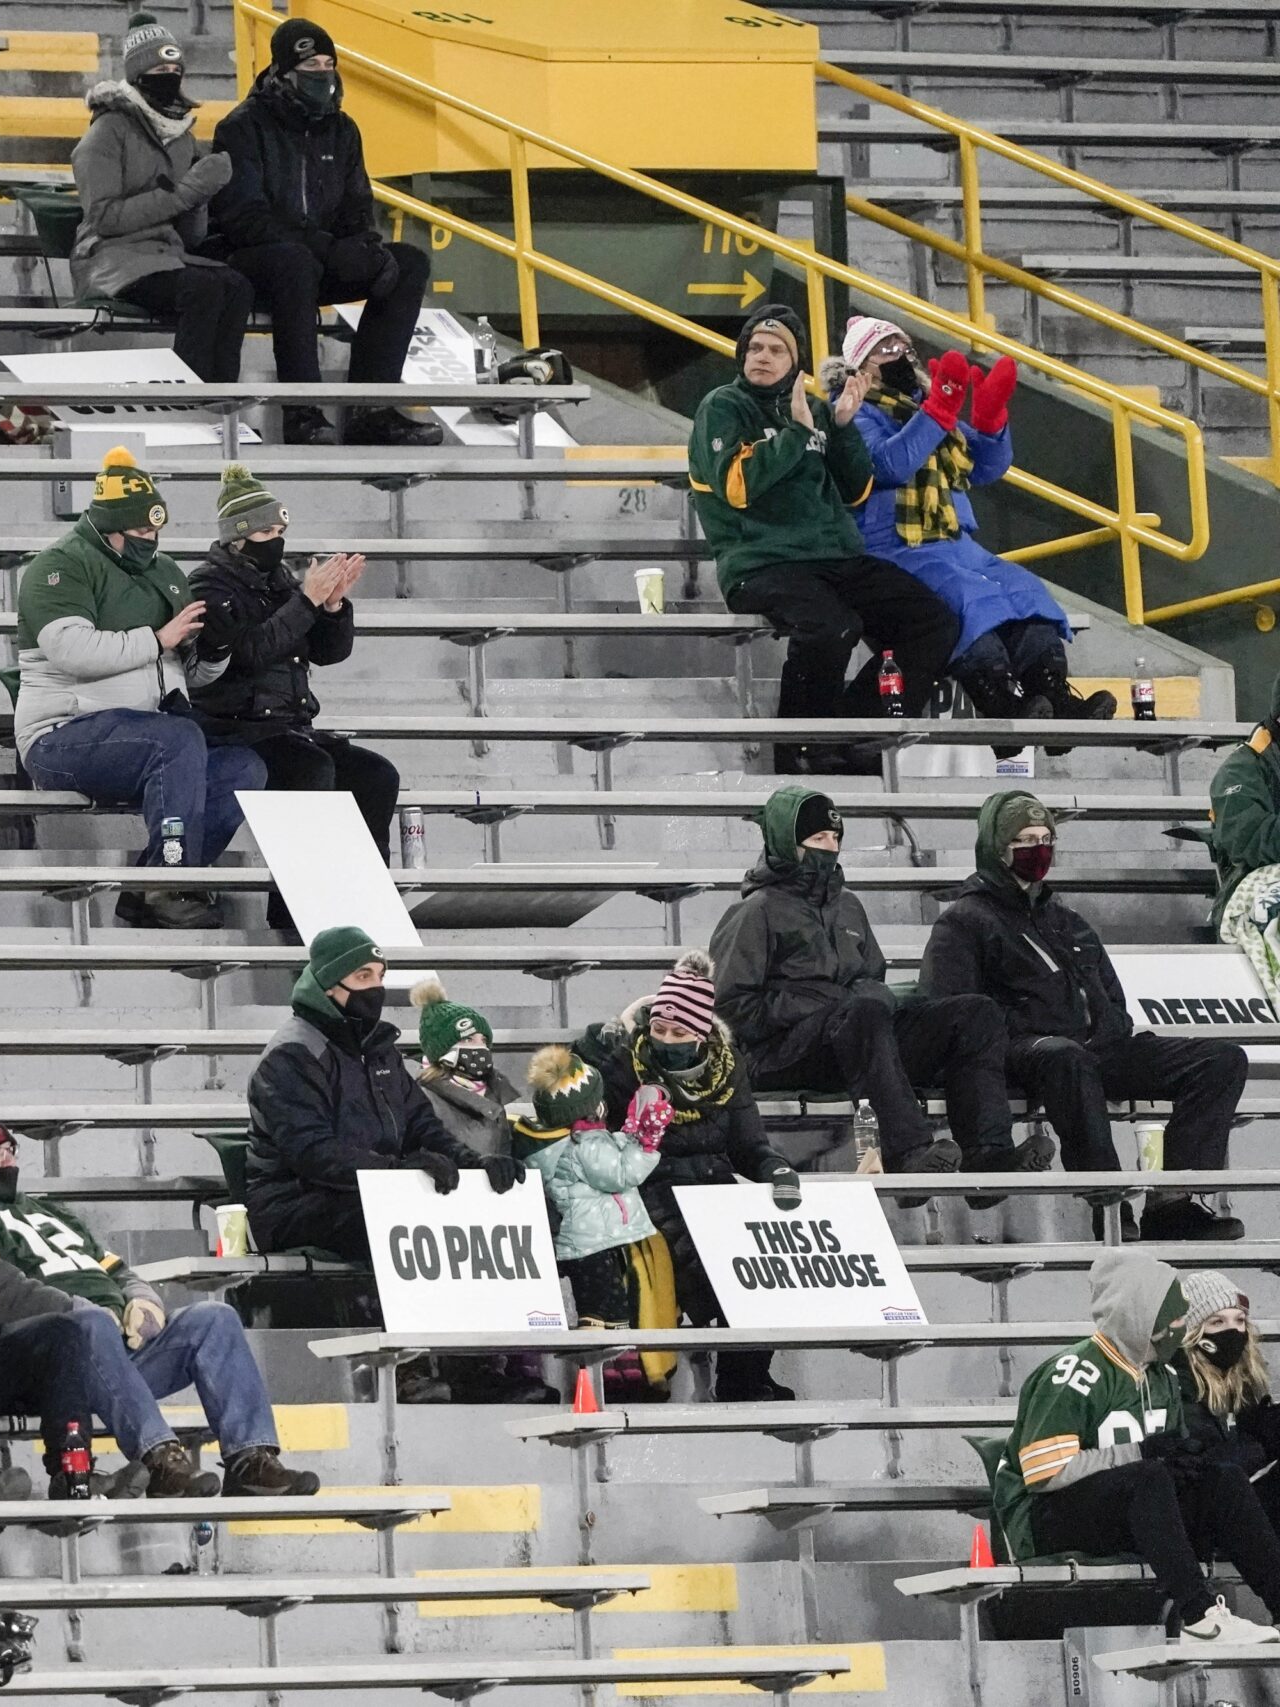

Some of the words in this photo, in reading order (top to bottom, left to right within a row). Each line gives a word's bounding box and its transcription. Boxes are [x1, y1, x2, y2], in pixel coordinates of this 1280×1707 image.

[389, 1224, 441, 1281] GO
[442, 1224, 541, 1280] PACK
[744, 1220, 812, 1254] THIS
[808, 1219, 842, 1253] IS
[732, 1256, 797, 1290] OUR
[790, 1254, 886, 1288] HOUSE
[1051, 1354, 1101, 1397] 92
